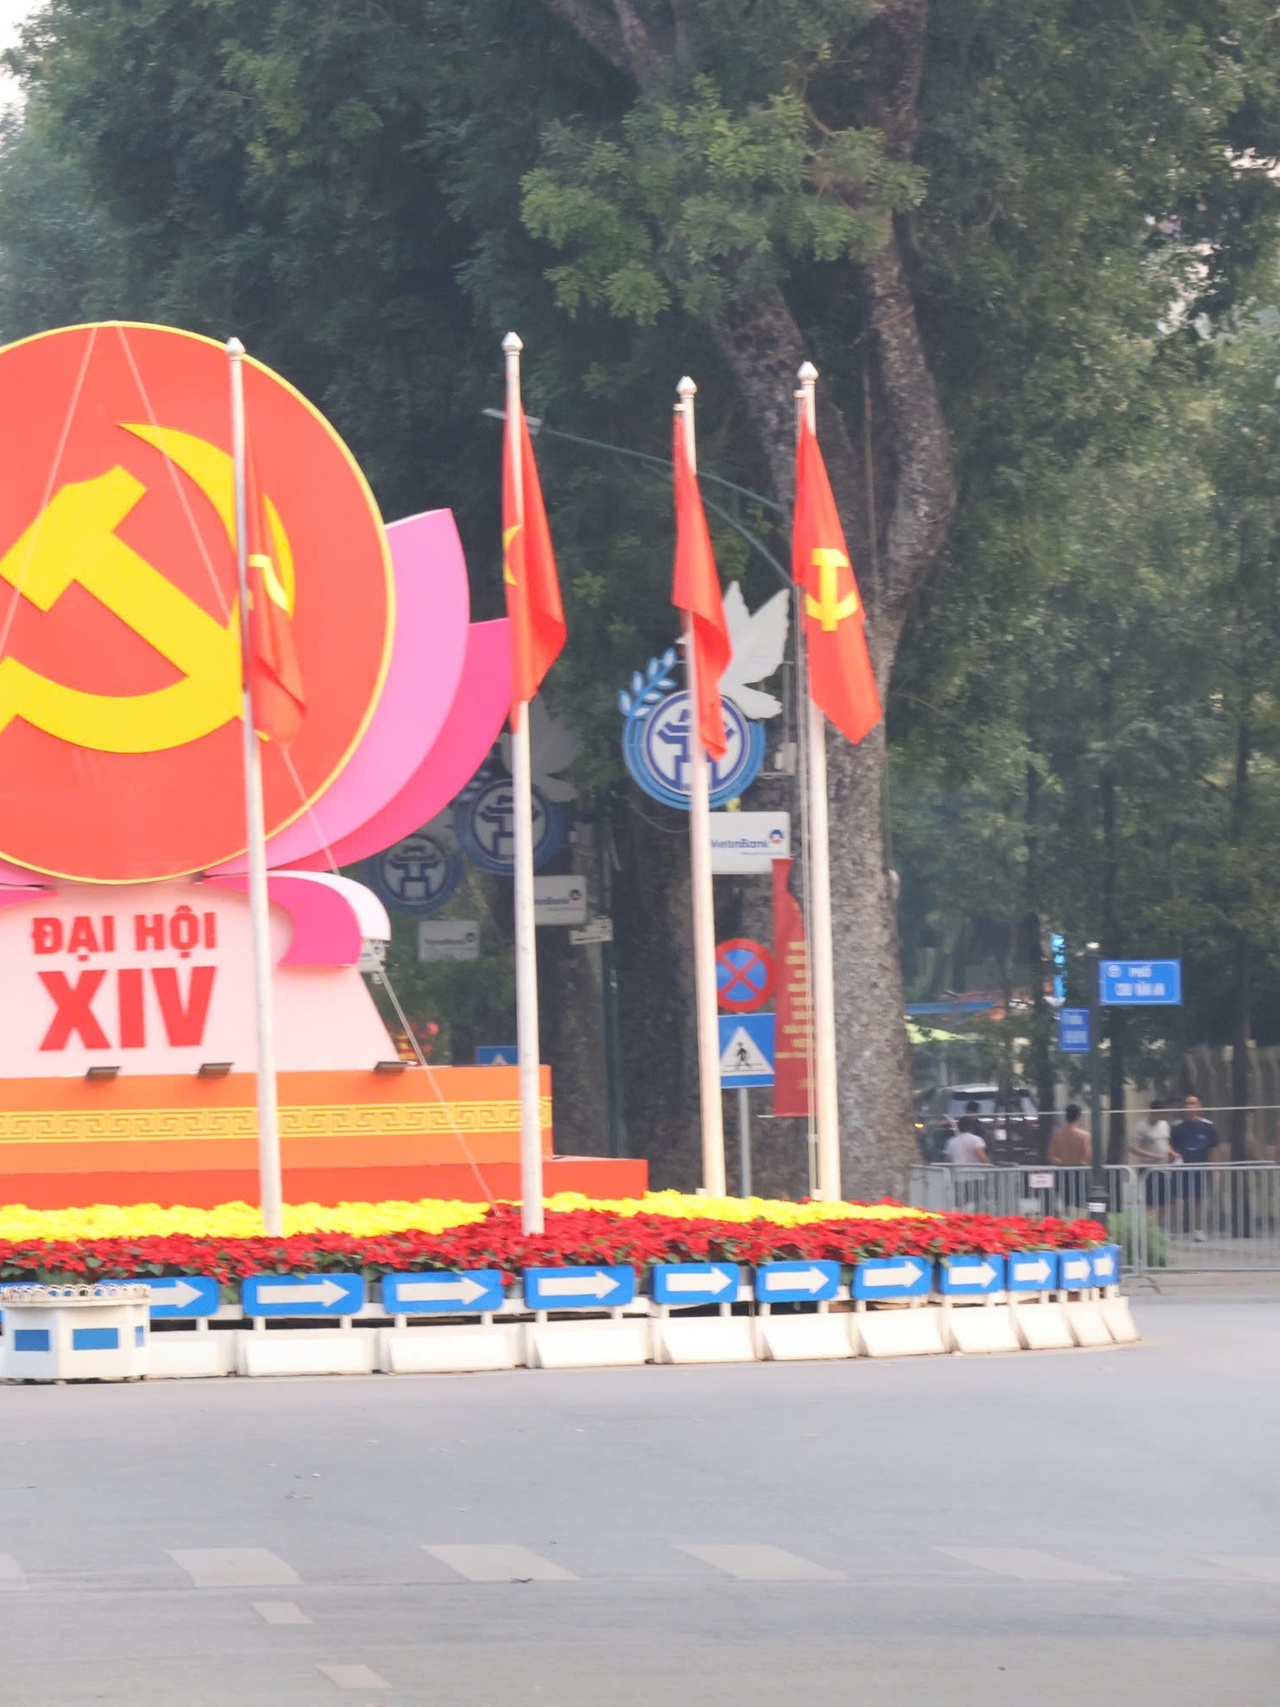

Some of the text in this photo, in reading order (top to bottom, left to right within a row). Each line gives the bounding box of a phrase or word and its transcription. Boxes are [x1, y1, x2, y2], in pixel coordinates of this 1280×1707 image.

[32, 904, 217, 962] ĐẠI HỘI
[37, 966, 218, 1052] XIV
